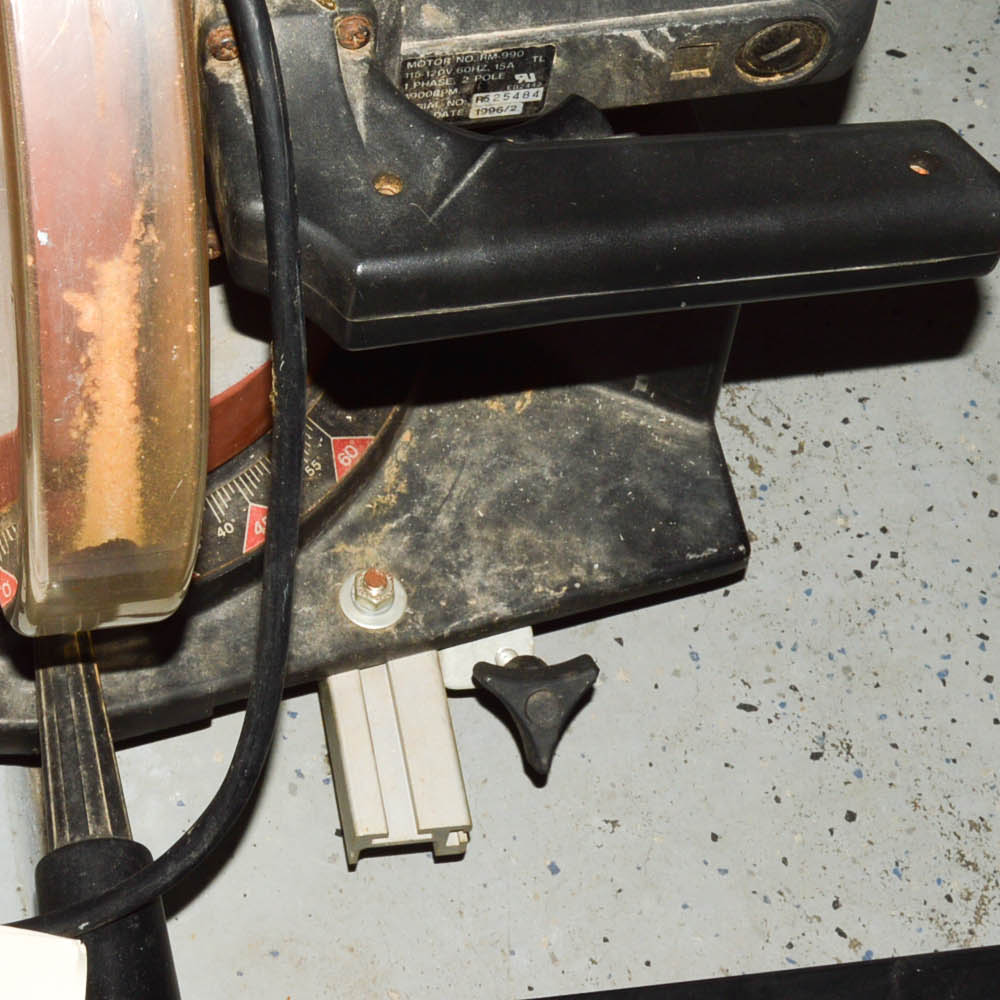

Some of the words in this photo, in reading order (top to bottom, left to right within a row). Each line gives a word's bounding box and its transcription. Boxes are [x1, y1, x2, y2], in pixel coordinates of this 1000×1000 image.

[407, 57, 451, 69] MOTOR
[474, 72, 505, 82] POLE
[476, 105, 518, 116] 1996/2
